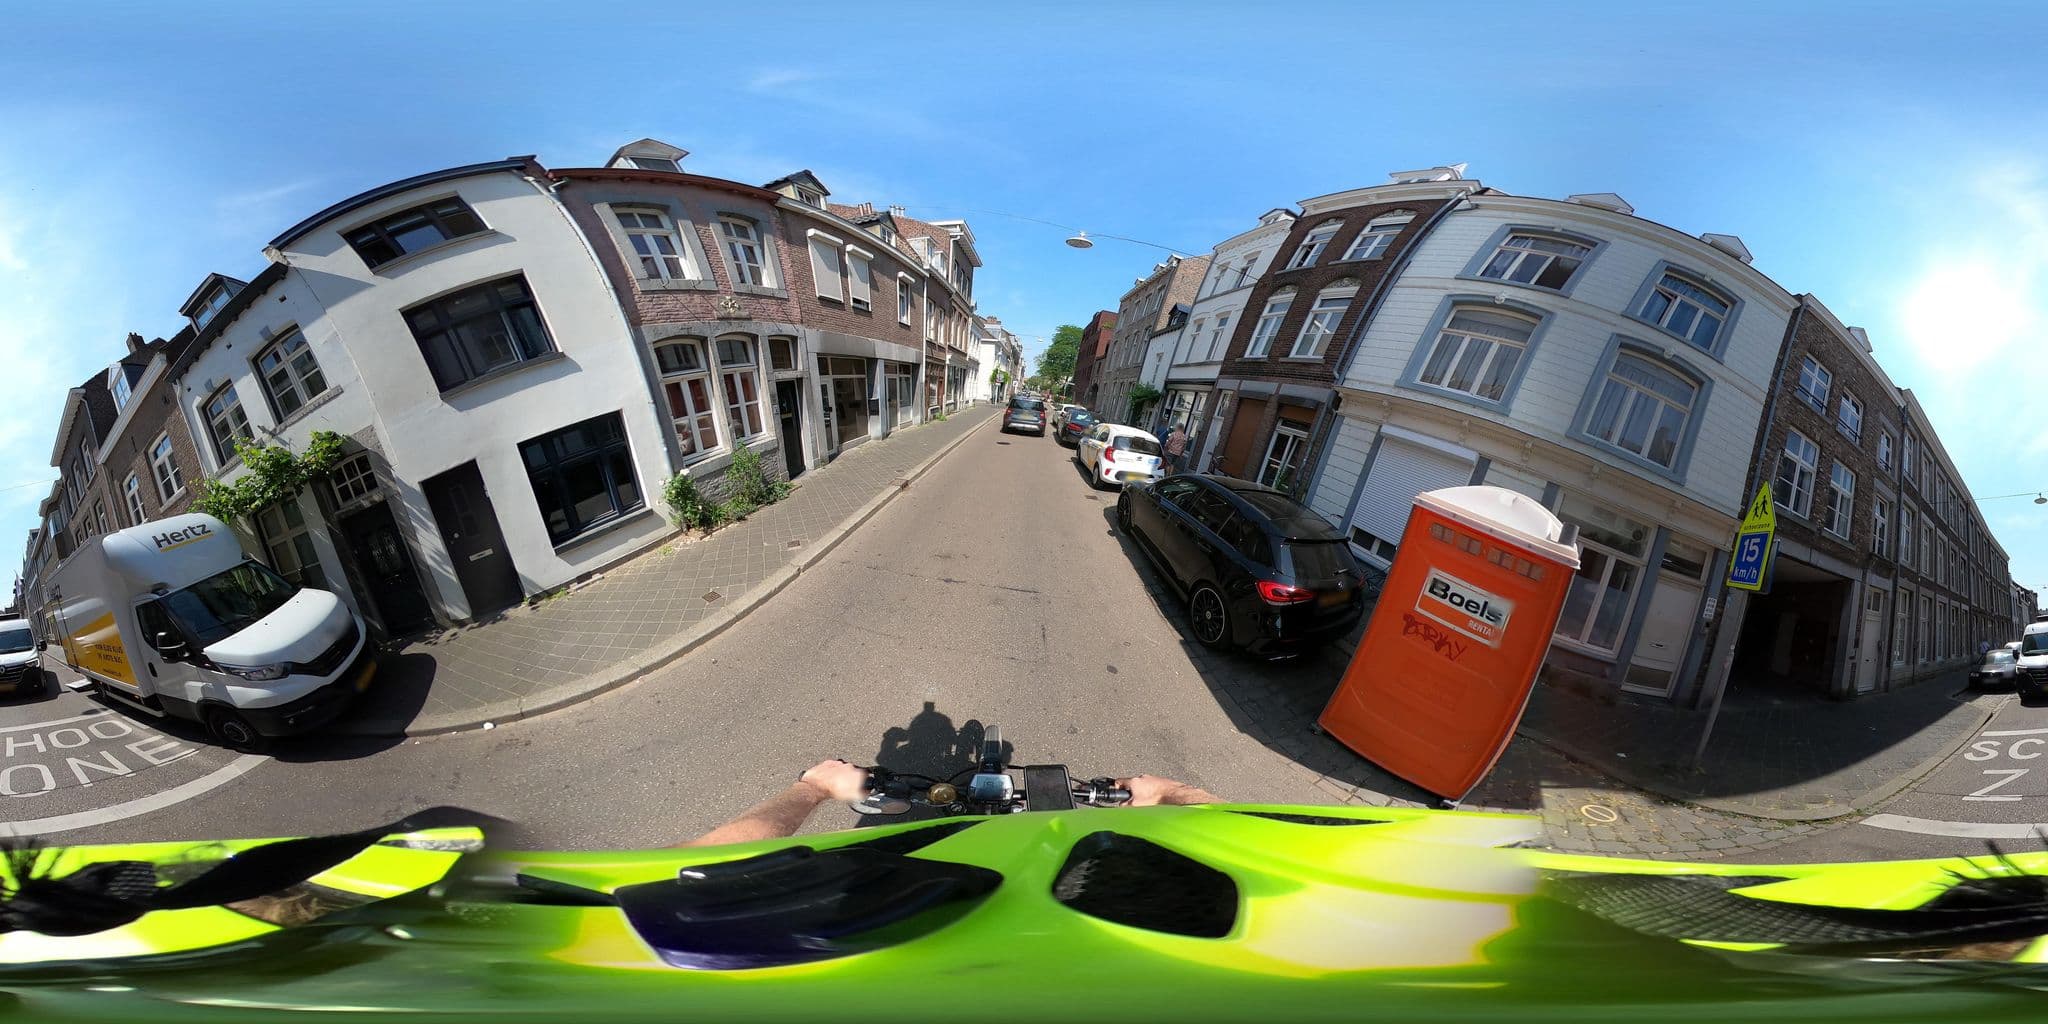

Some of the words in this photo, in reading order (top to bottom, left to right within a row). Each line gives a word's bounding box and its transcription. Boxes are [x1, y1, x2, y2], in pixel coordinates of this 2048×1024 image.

[152, 524, 211, 548] Hertz
[1741, 538, 1761, 562] 15
[1733, 566, 1758, 580] km/h
[1428, 577, 1503, 623] Boels
[1964, 738, 2046, 761] SC
[0, 734, 201, 798] ONE
[1961, 768, 2030, 802] Z
